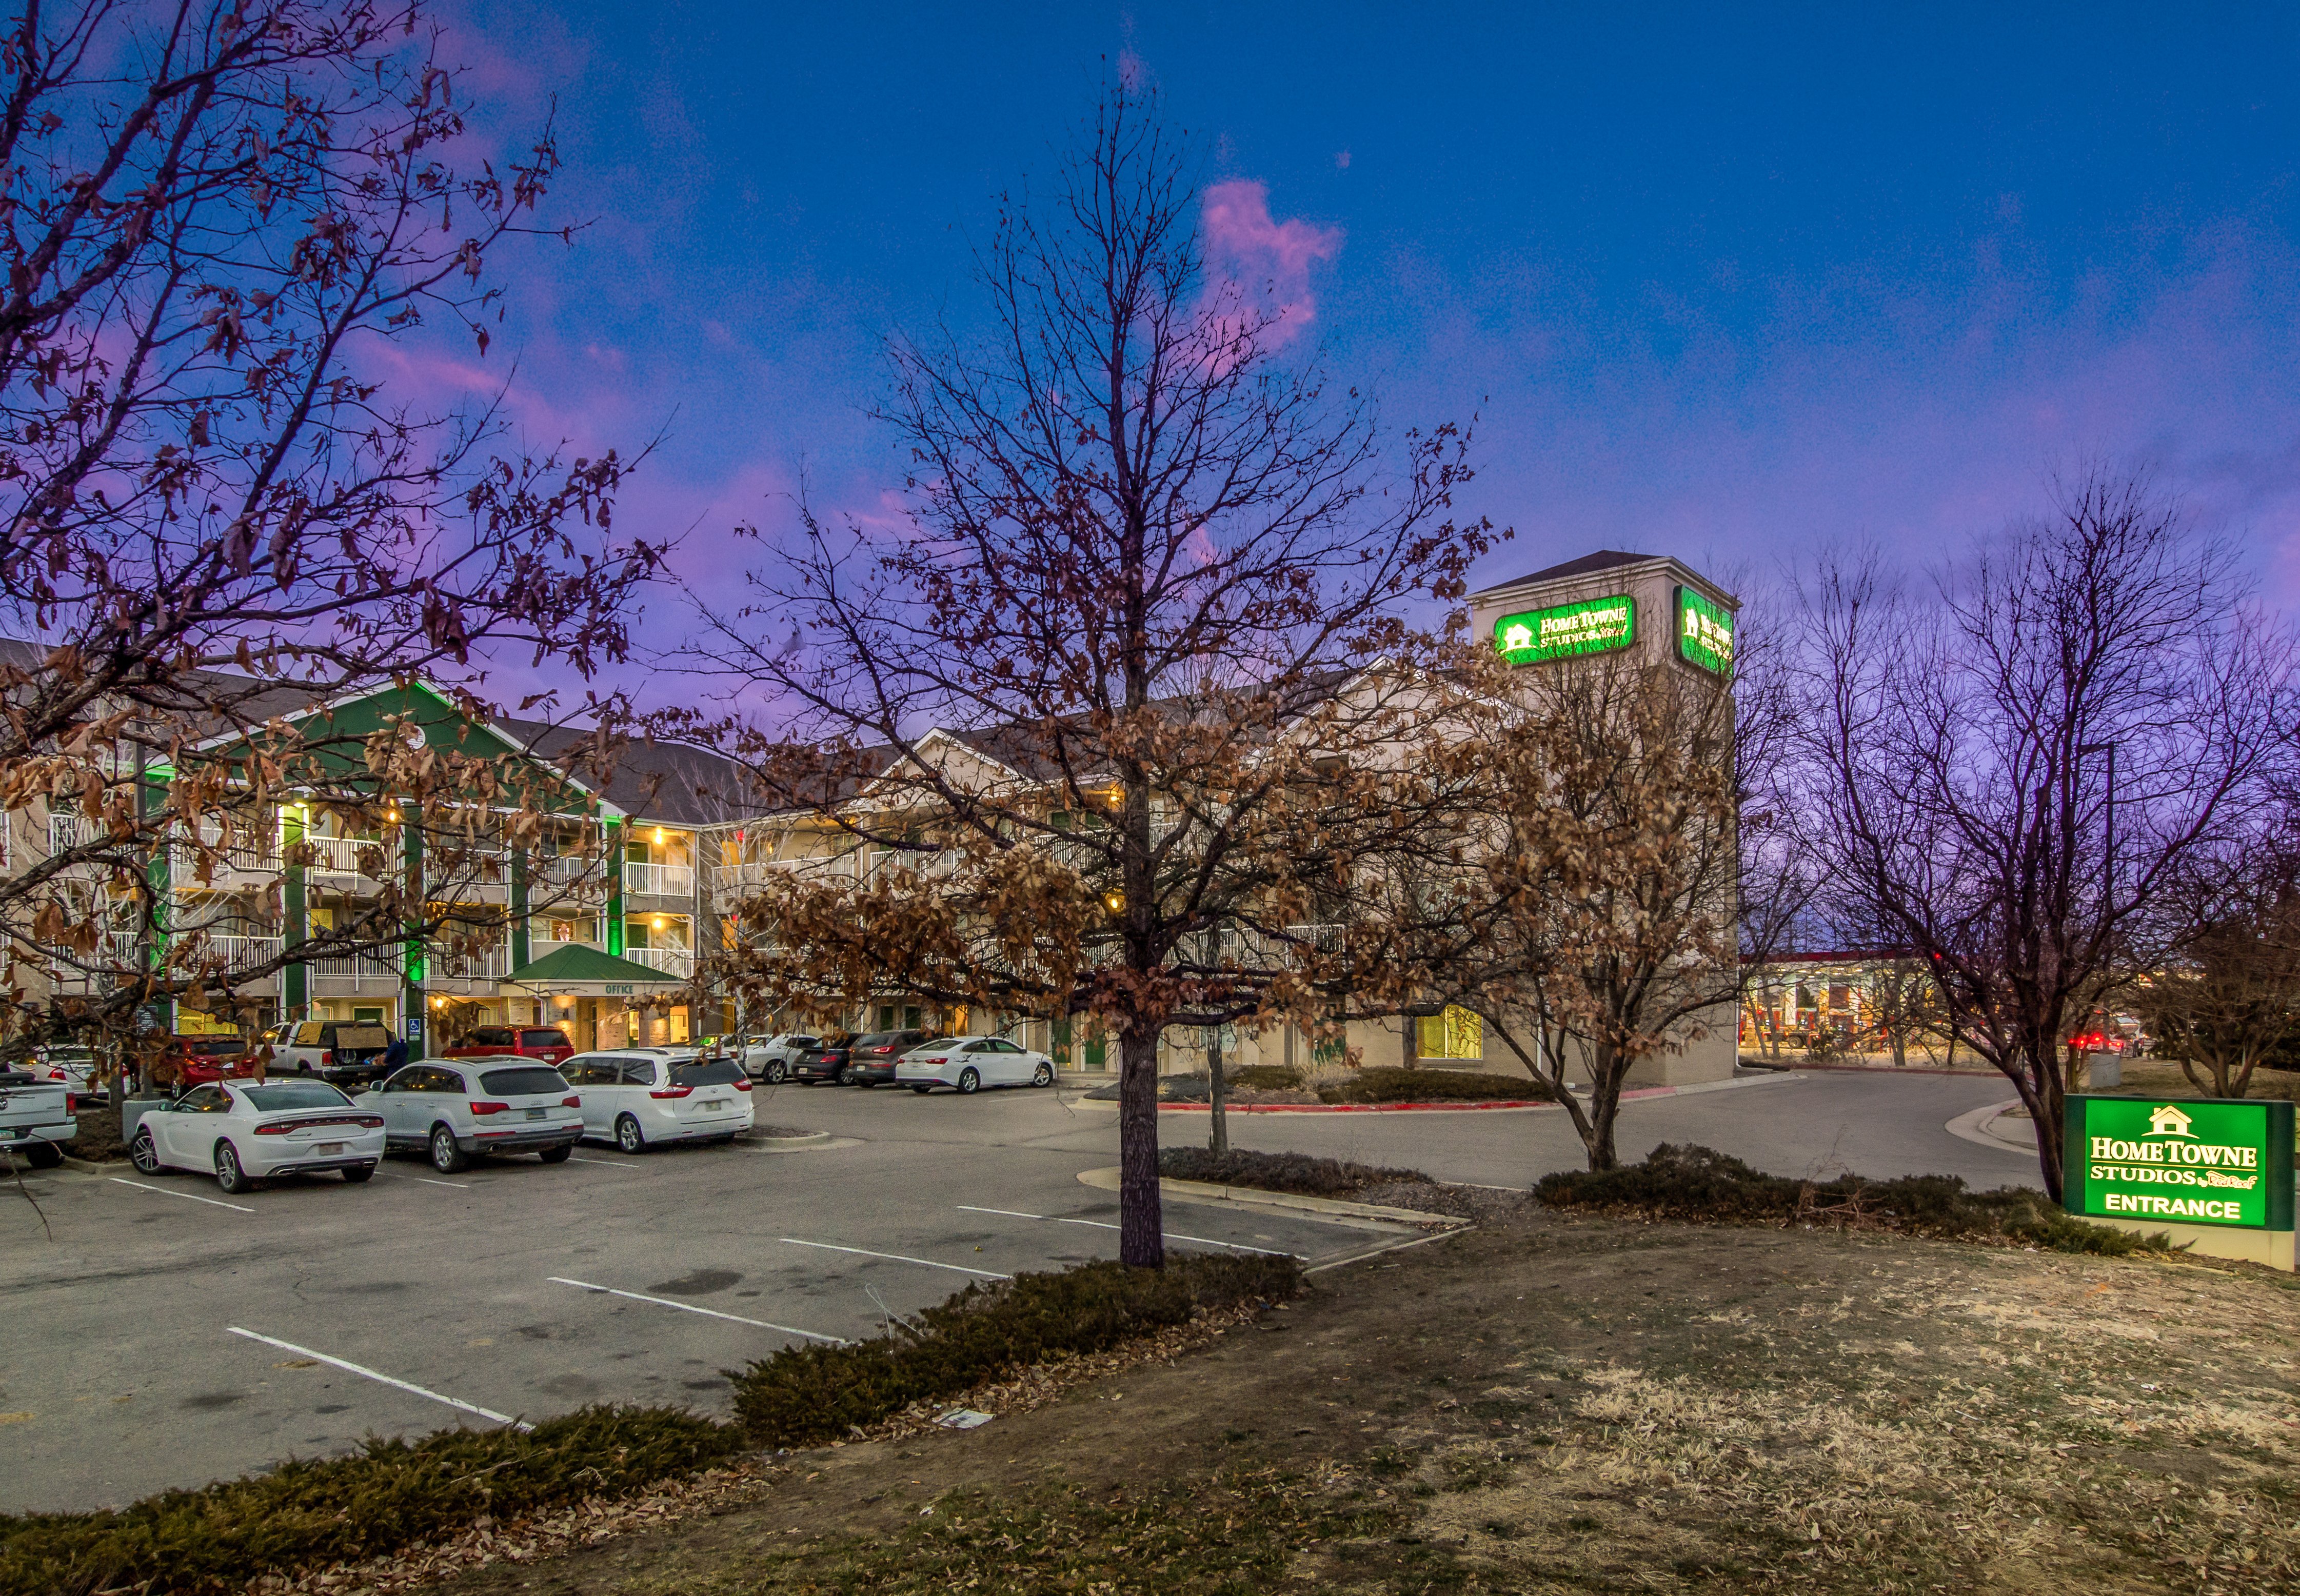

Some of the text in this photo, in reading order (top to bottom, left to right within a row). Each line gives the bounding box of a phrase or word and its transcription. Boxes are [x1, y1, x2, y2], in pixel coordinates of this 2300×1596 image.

[606, 985, 633, 994] OFFICE
[2091, 1166, 2196, 1185] STUDIOS
[2106, 1194, 2240, 1219] ENTRANCE
